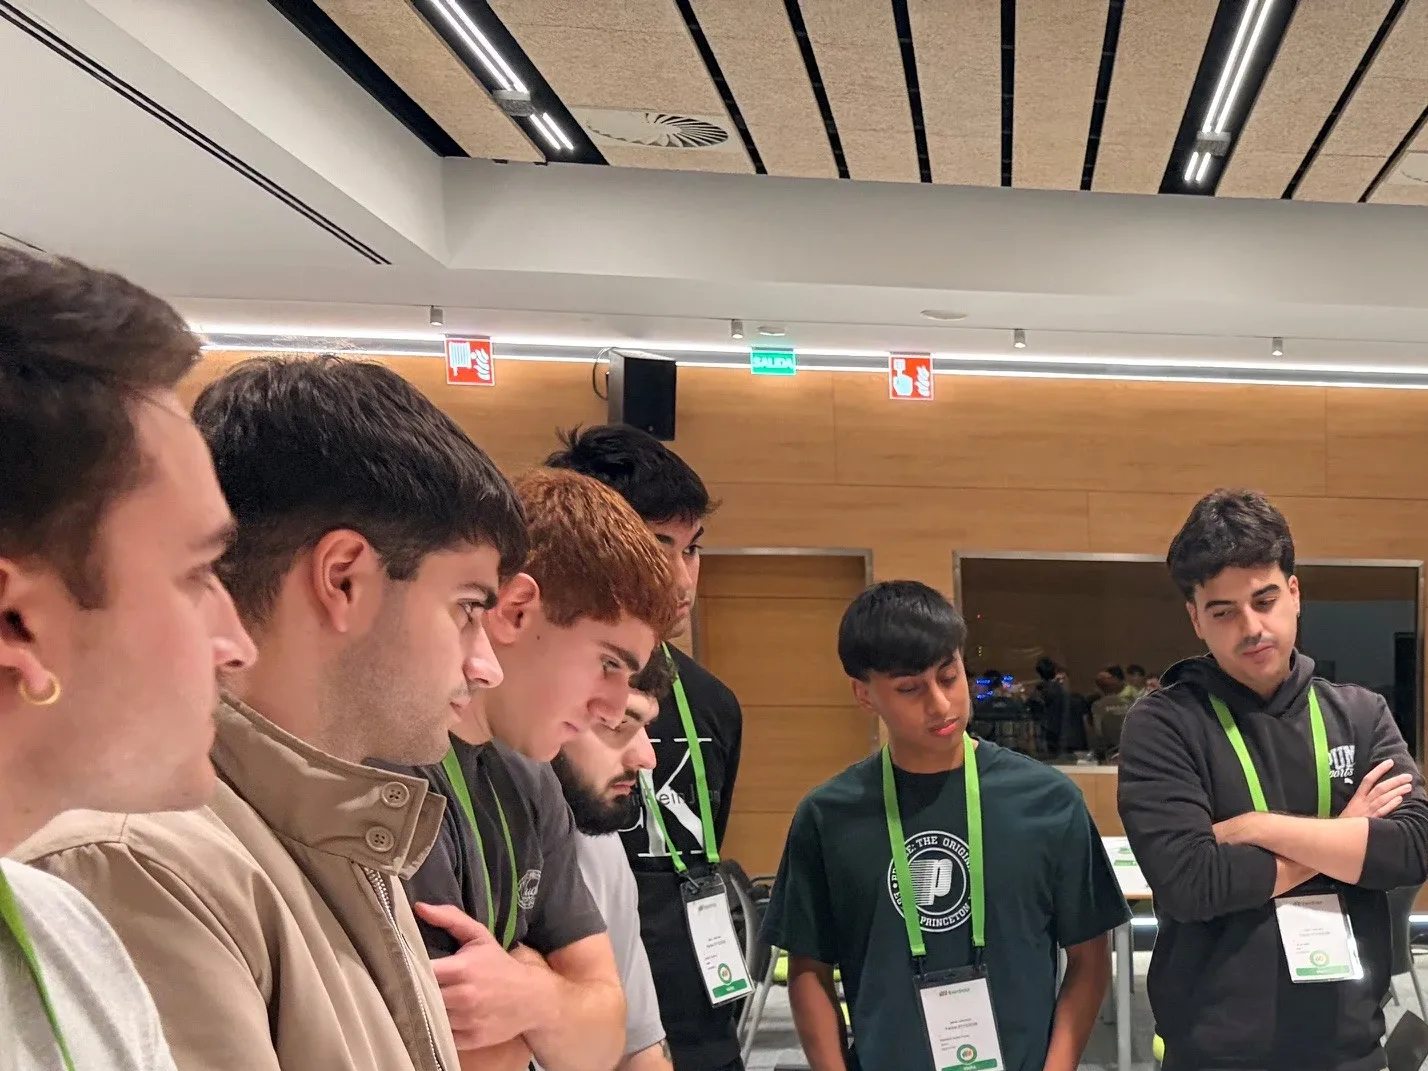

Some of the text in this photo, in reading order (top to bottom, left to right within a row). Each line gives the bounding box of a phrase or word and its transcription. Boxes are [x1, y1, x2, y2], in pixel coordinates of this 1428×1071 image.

[753, 356, 794, 368] SALIDA
[916, 836, 938, 848] THE
[919, 902, 971, 927] PRINCETON
